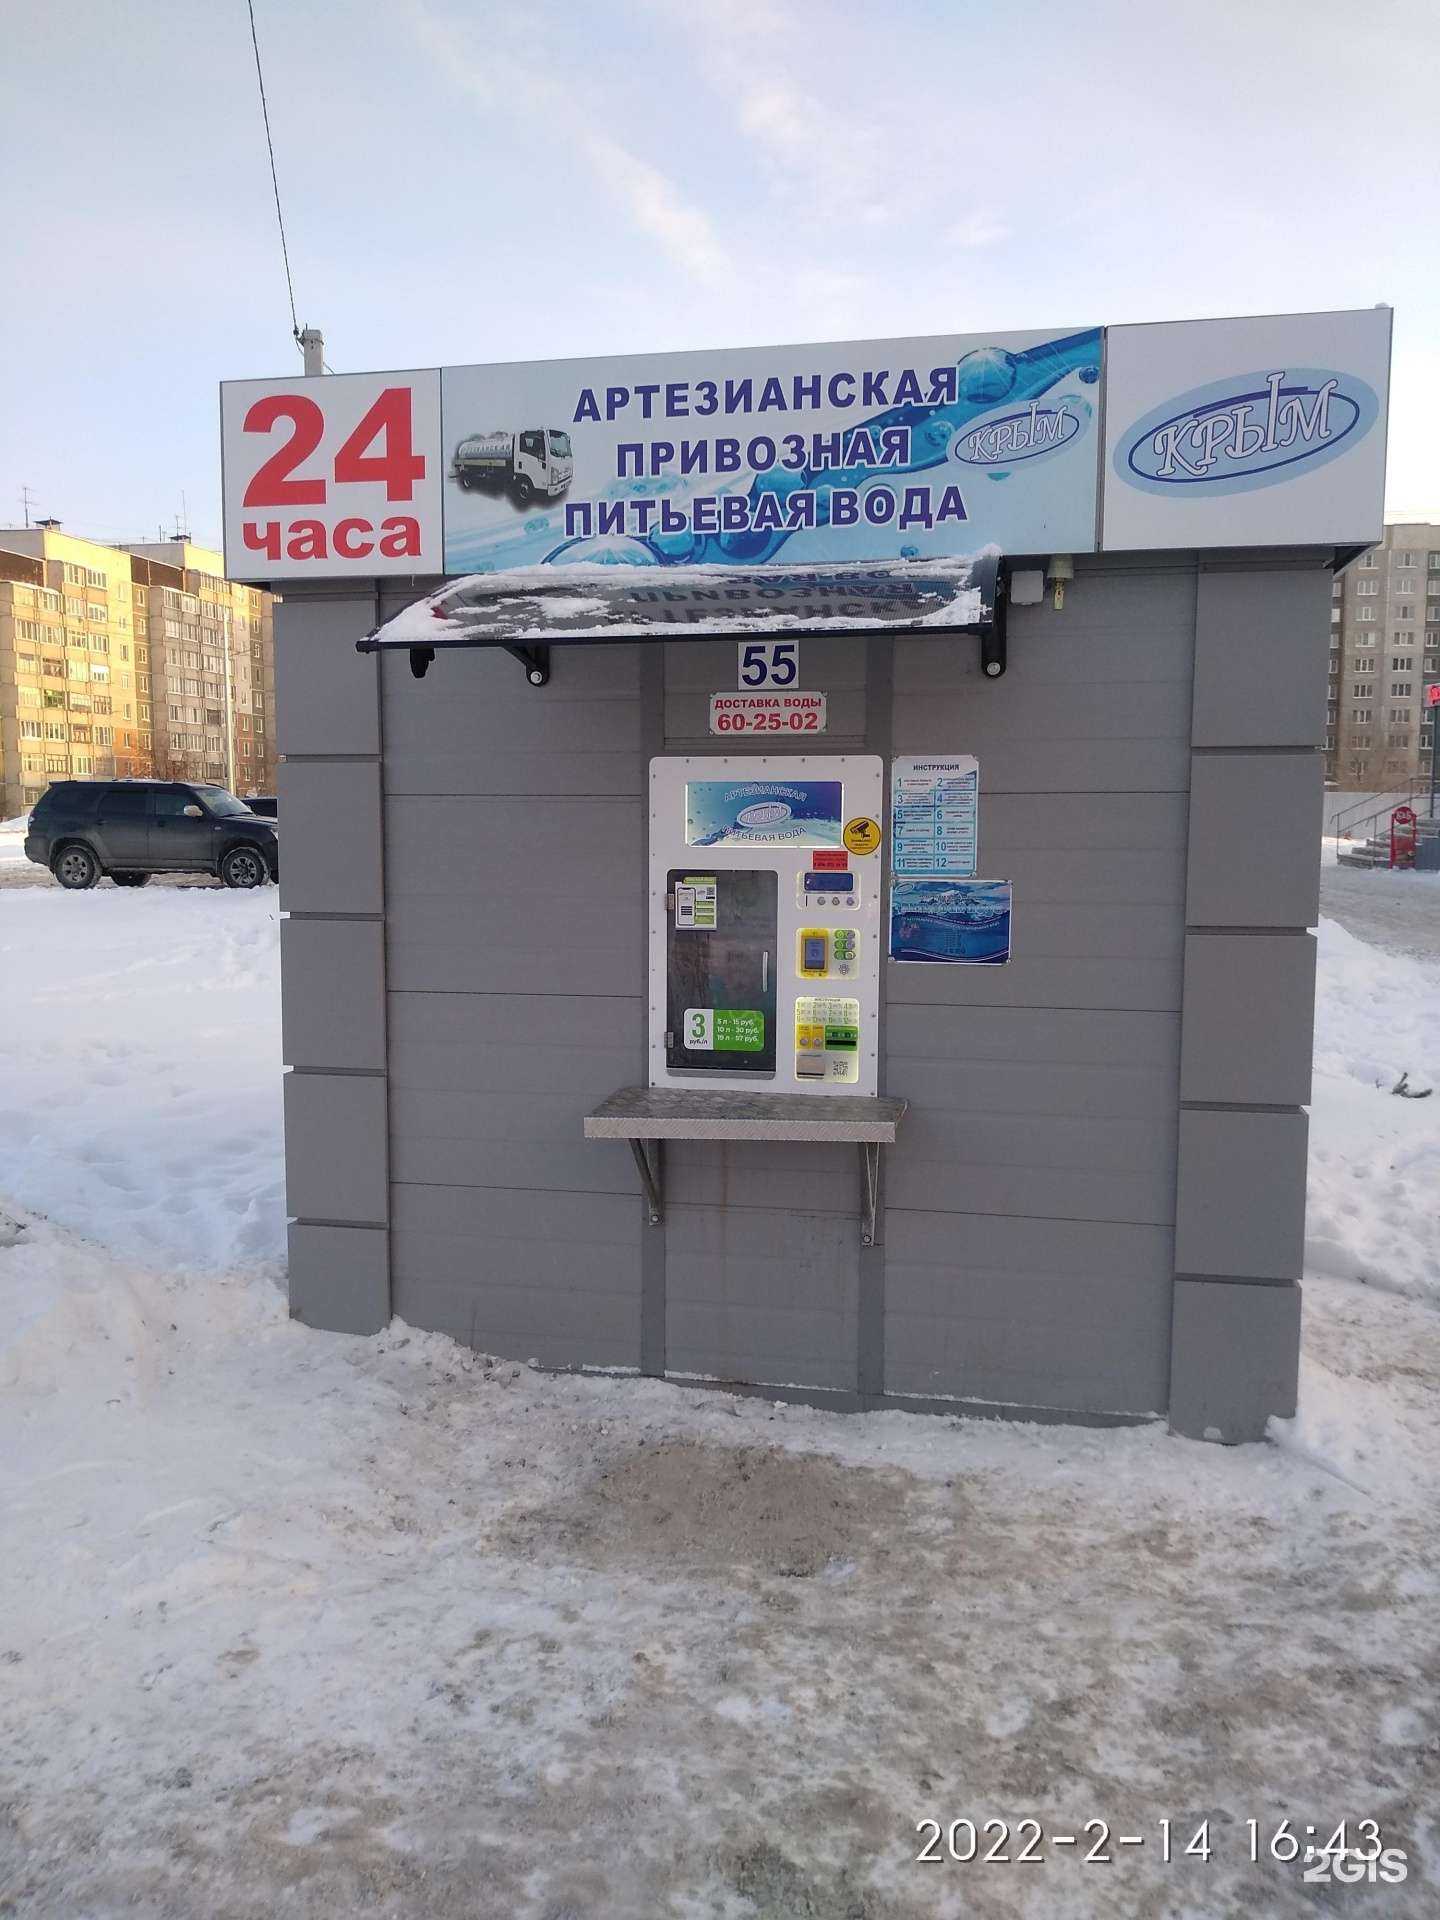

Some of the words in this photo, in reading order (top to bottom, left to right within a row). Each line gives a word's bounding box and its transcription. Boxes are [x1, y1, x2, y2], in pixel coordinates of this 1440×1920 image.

[572, 366, 957, 422] АРТЕЗИАНСКАЯ
[1153, 372, 1338, 476] КРЫМ
[968, 401, 1068, 462] КРЫМ
[243, 387, 425, 507] 24
[617, 427, 909, 477] ПРИВОЗНАЯ
[565, 492, 814, 536] ПИТЬЕВАЯ
[831, 485, 967, 529] ВОДА
[243, 516, 421, 560] часа
[742, 645, 796, 686] 55
[715, 699, 780, 710] ДОСТАВКА
[784, 698, 821, 708] ВОДЫ
[717, 712, 818, 731] 60-25-02
[913, 764, 960, 772] ИНСТРУКЦИЯ
[936, 778, 943, 787] 2
[724, 783, 807, 801] АРТЕЗИАНСКАЯ
[897, 795, 903, 804] 3
[897, 810, 903, 819] 5
[936, 810, 943, 820] 6
[722, 825, 776, 841] ПИТЬЕВАЯ
[778, 826, 807, 840] ВОДА
[897, 826, 903, 835] 7
[936, 826, 943, 835] 8
[897, 843, 903, 852] 9
[935, 842, 946, 852] 10
[897, 858, 905, 868] 11
[936, 858, 947, 868] 12
[692, 1013, 706, 1038] 3
